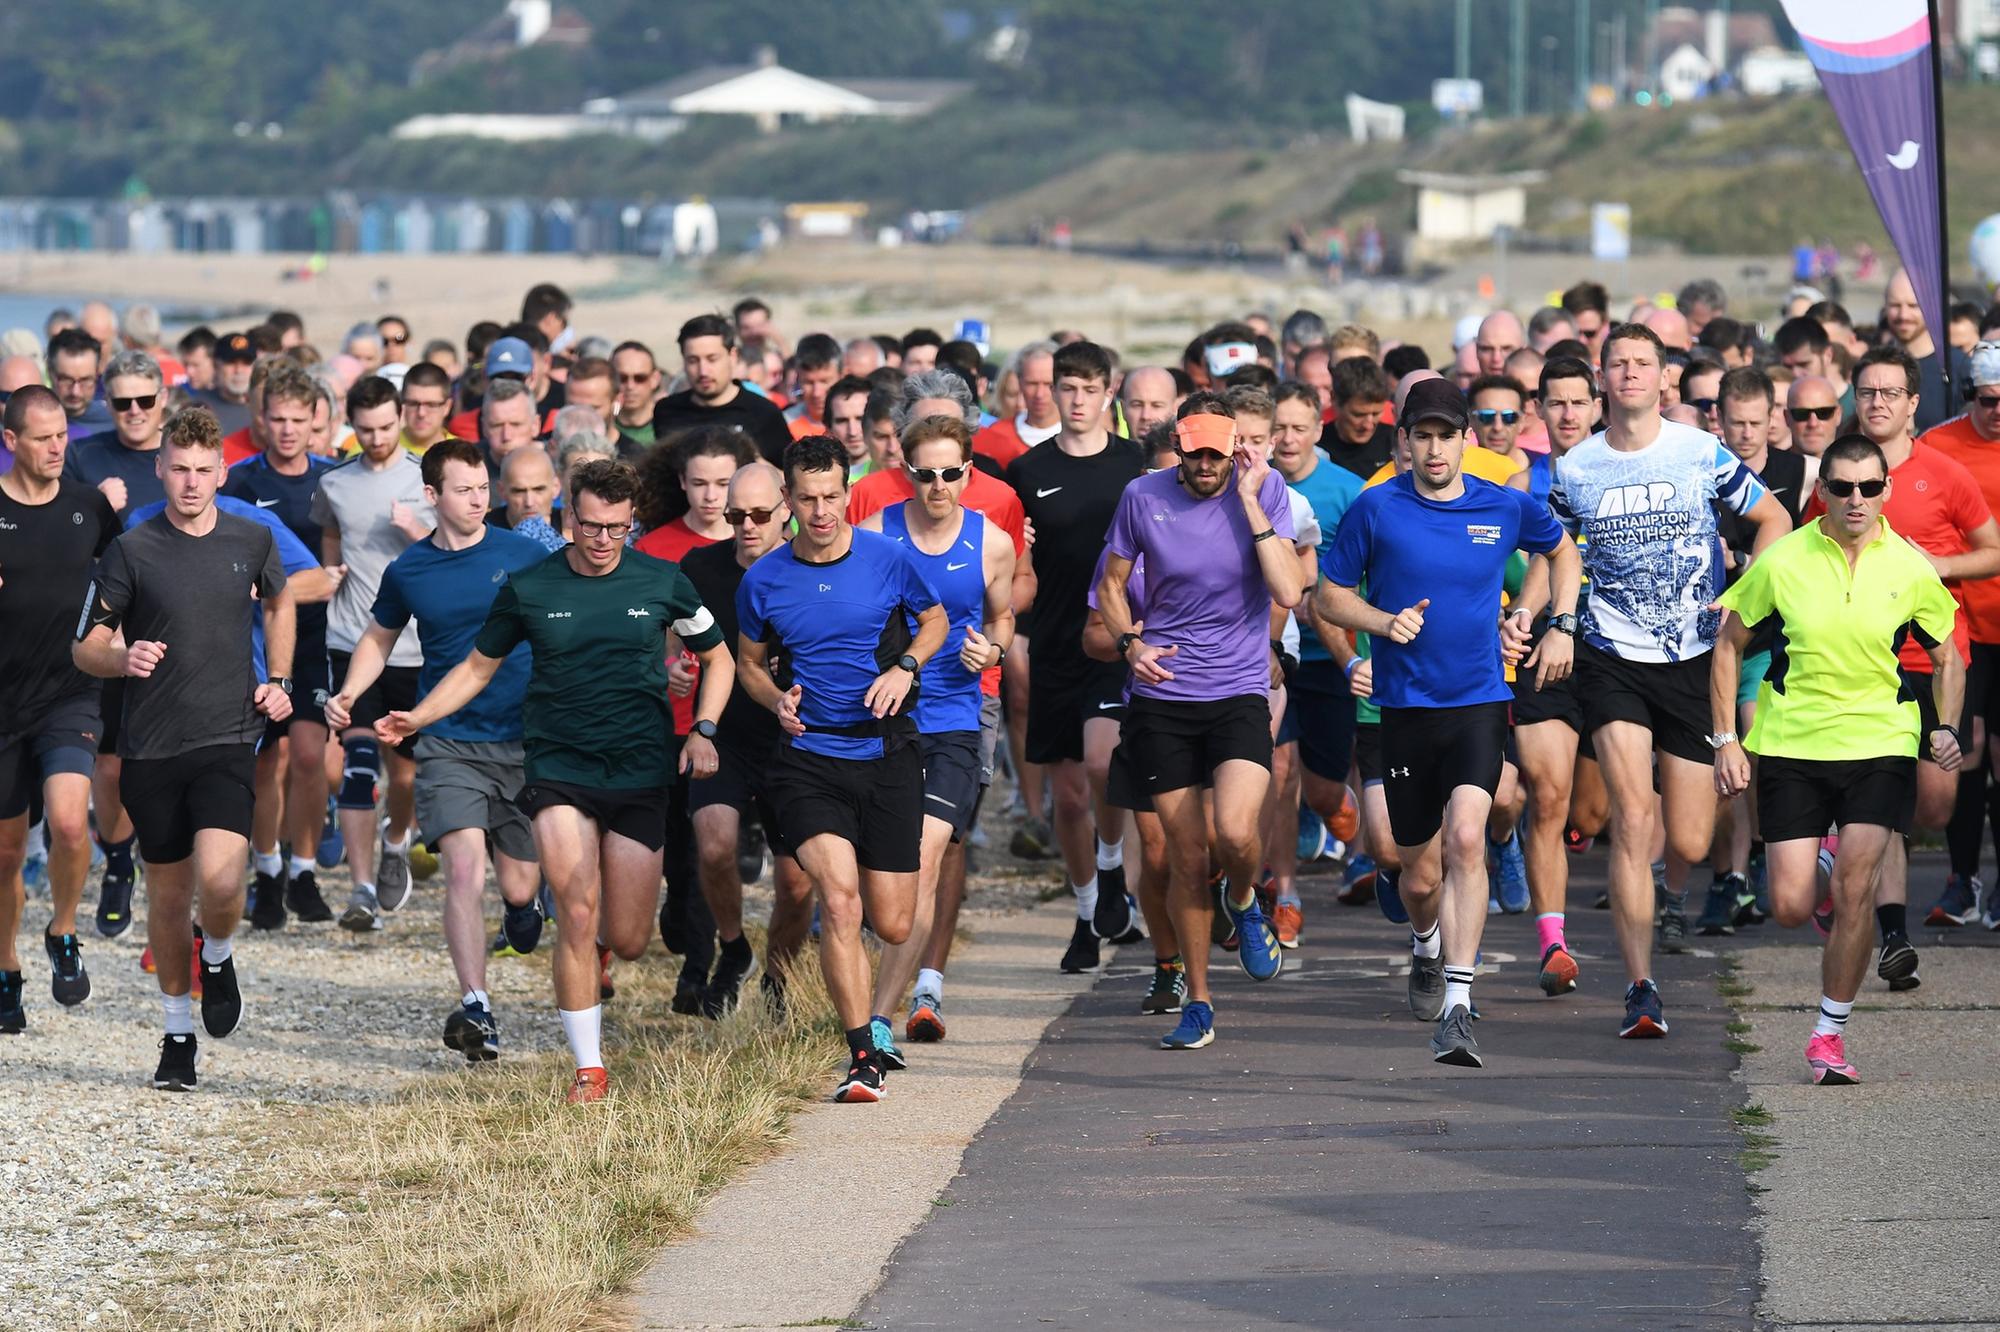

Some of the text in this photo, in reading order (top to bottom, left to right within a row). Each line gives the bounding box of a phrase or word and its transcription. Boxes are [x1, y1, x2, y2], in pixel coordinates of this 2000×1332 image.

[1596, 481, 1676, 519] ABP
[1587, 511, 1689, 533] SOUTHAMPTON
[1590, 524, 1689, 545] MARATHON
